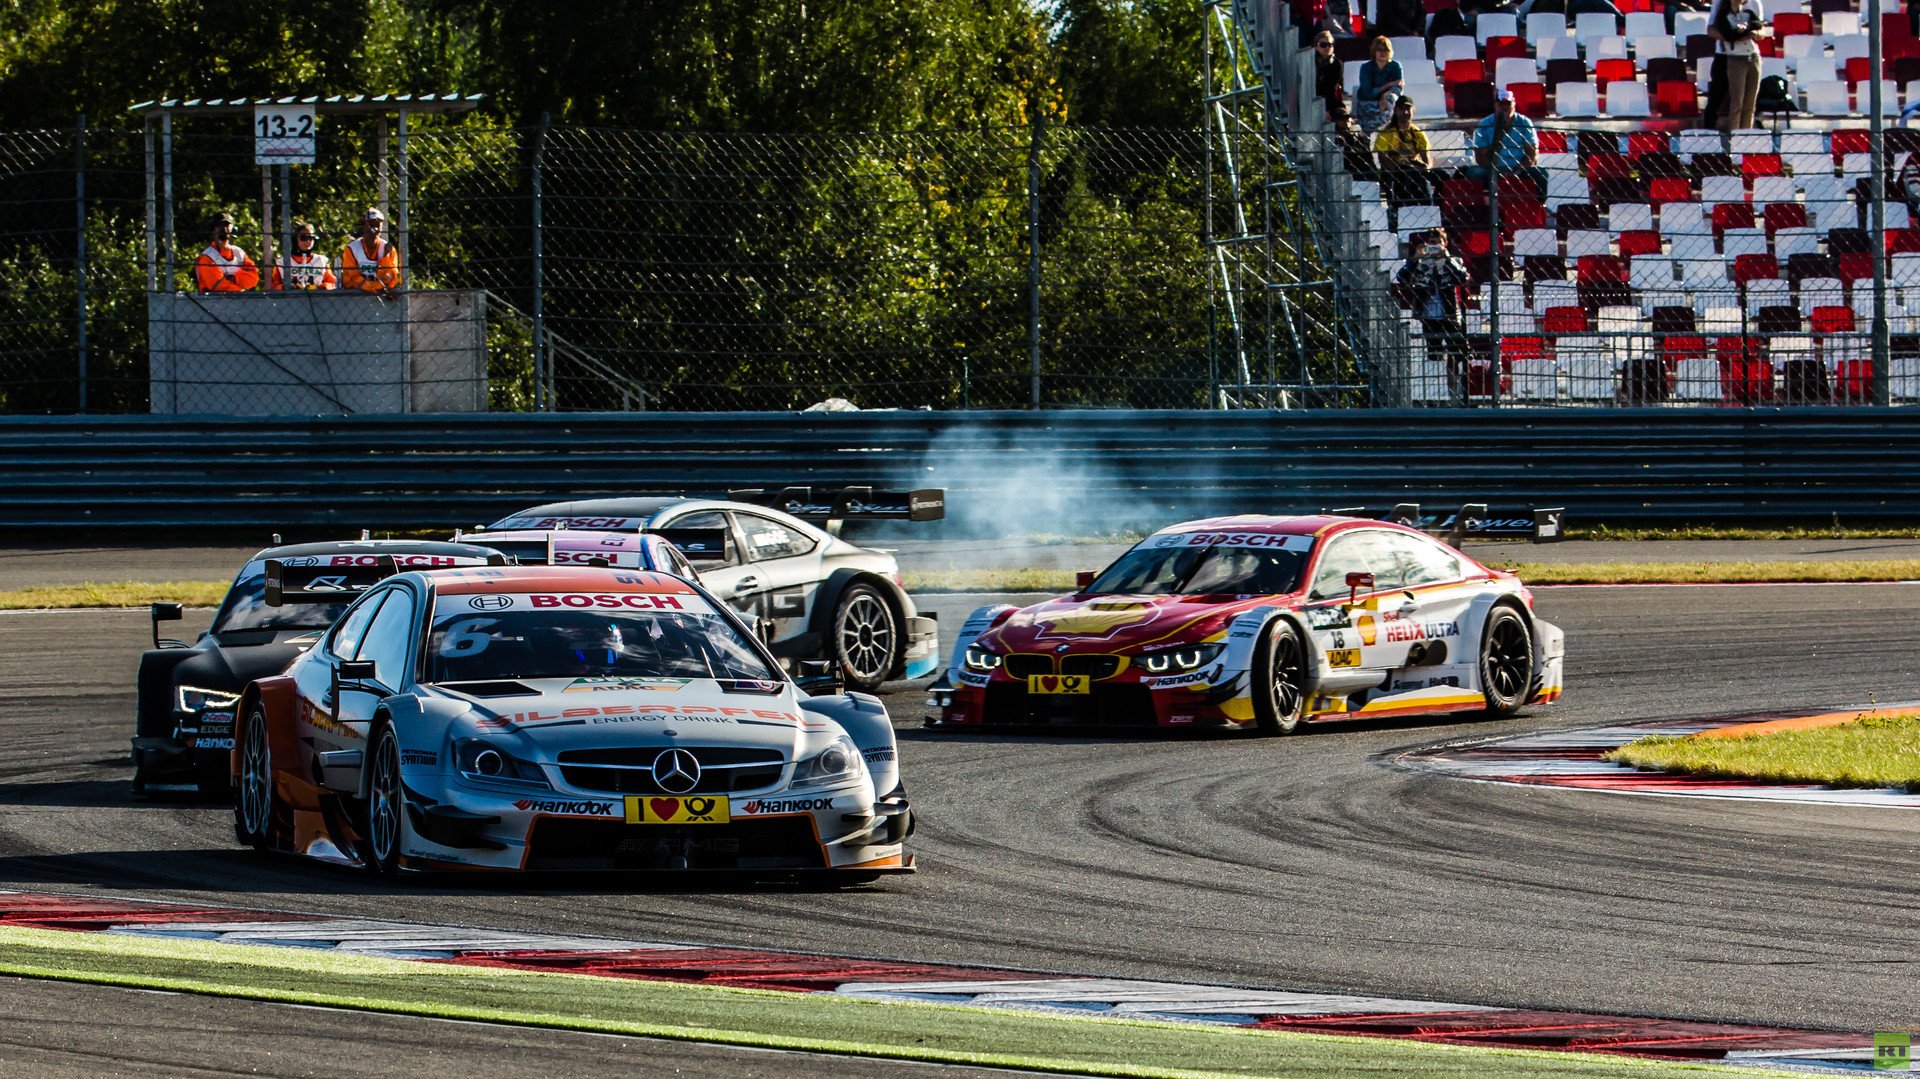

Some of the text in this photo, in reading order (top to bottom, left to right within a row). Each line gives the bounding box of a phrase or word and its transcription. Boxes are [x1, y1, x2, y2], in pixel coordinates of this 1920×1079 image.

[257, 114, 314, 139] 13-2
[534, 517, 628, 528] BOSCH
[1188, 533, 1289, 547] BOSCH
[554, 552, 618, 564] SCH
[530, 594, 685, 610] BOSCH
[439, 617, 499, 658] 6
[1331, 630, 1345, 649] 18
[1386, 621, 1460, 643] HELIX ULTRA
[1330, 650, 1353, 667] ADAC
[592, 684, 656, 692] ADAC
[1034, 676, 1039, 693] I
[475, 704, 826, 729] SILBERPFEIL
[592, 714, 734, 725] ENERGY DRINK
[637, 797, 644, 822] I
